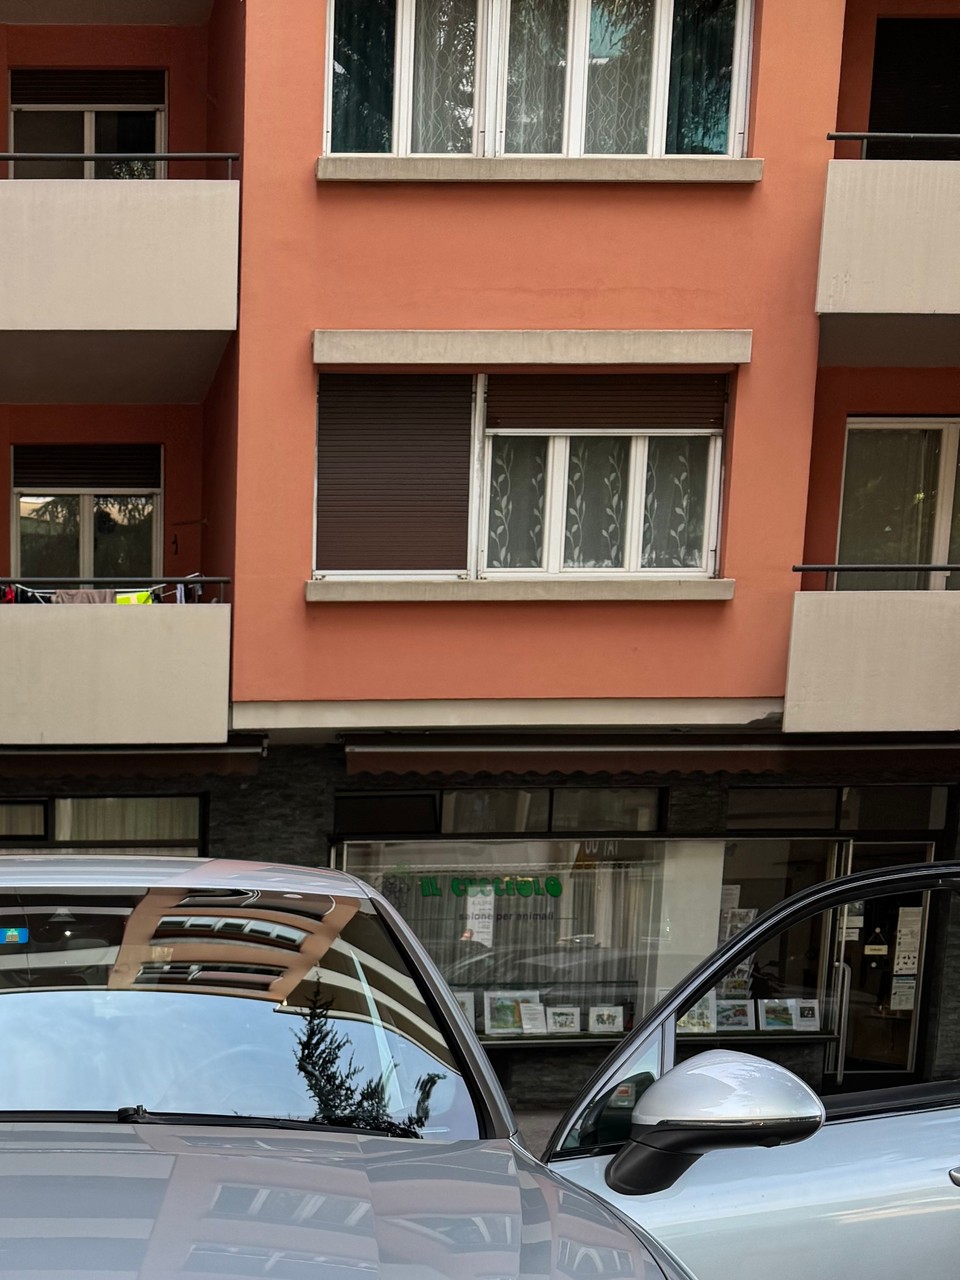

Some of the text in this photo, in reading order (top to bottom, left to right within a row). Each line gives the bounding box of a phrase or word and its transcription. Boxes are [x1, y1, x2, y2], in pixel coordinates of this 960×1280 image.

[420, 875, 563, 897] IL CUCCIOLO
[458, 911, 554, 922] salone per animali
